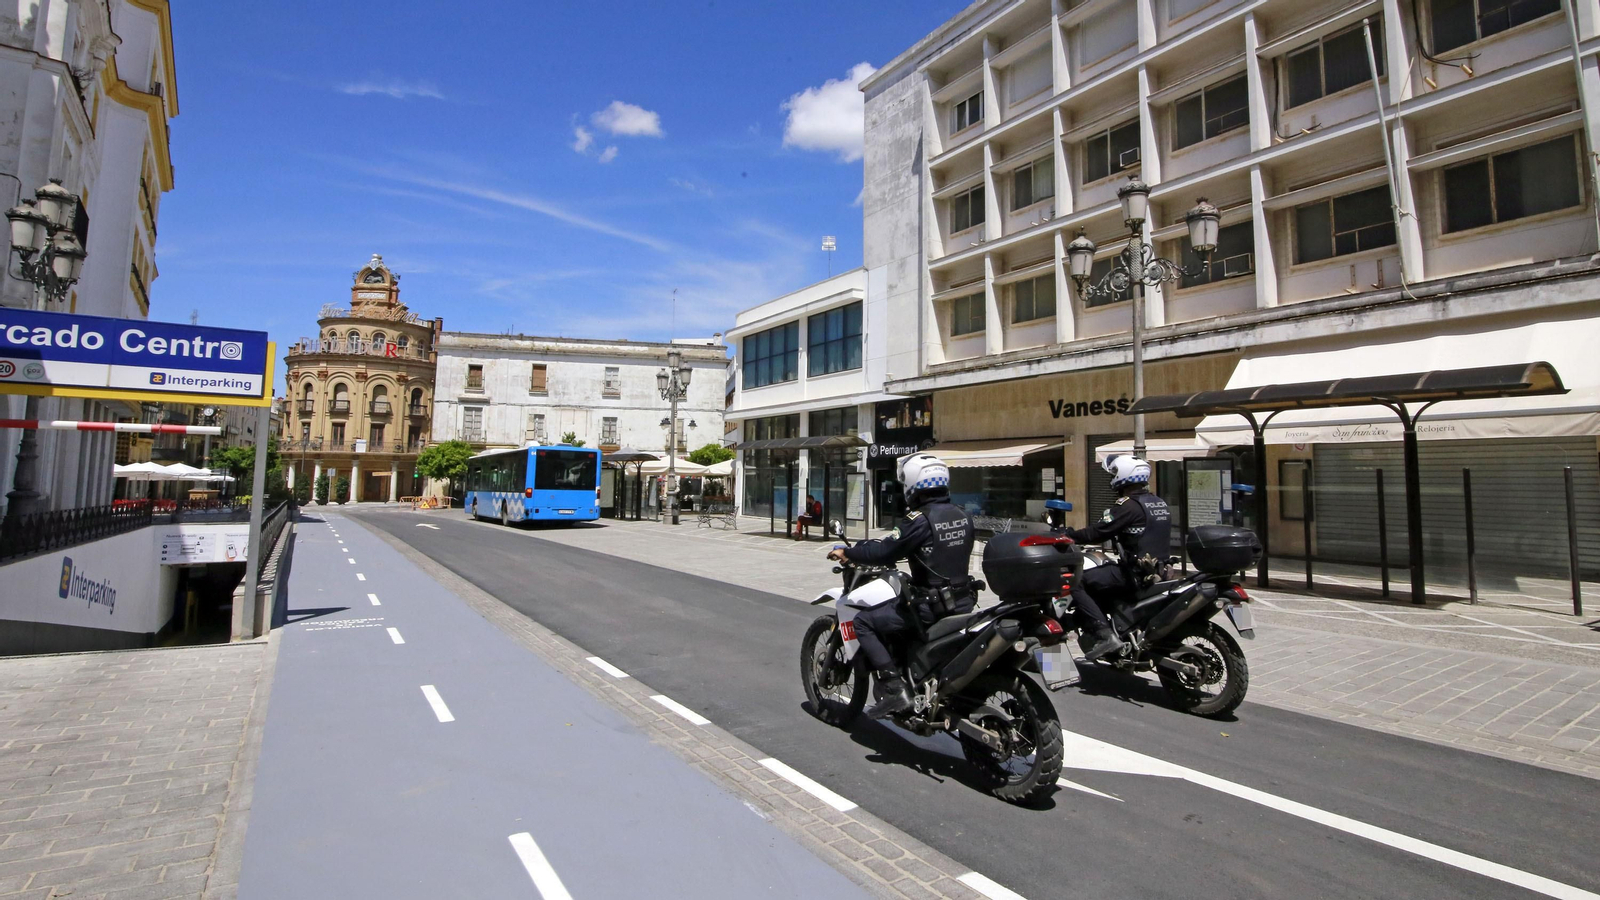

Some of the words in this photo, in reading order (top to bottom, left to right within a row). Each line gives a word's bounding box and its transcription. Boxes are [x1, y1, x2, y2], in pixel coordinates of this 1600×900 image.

[167, 375, 252, 391] Interparking
[1048, 399, 1135, 419] Vaness
[880, 444, 918, 455] Perfumart
[934, 518, 969, 531] POLICIA
[70, 566, 117, 615] Interparking
